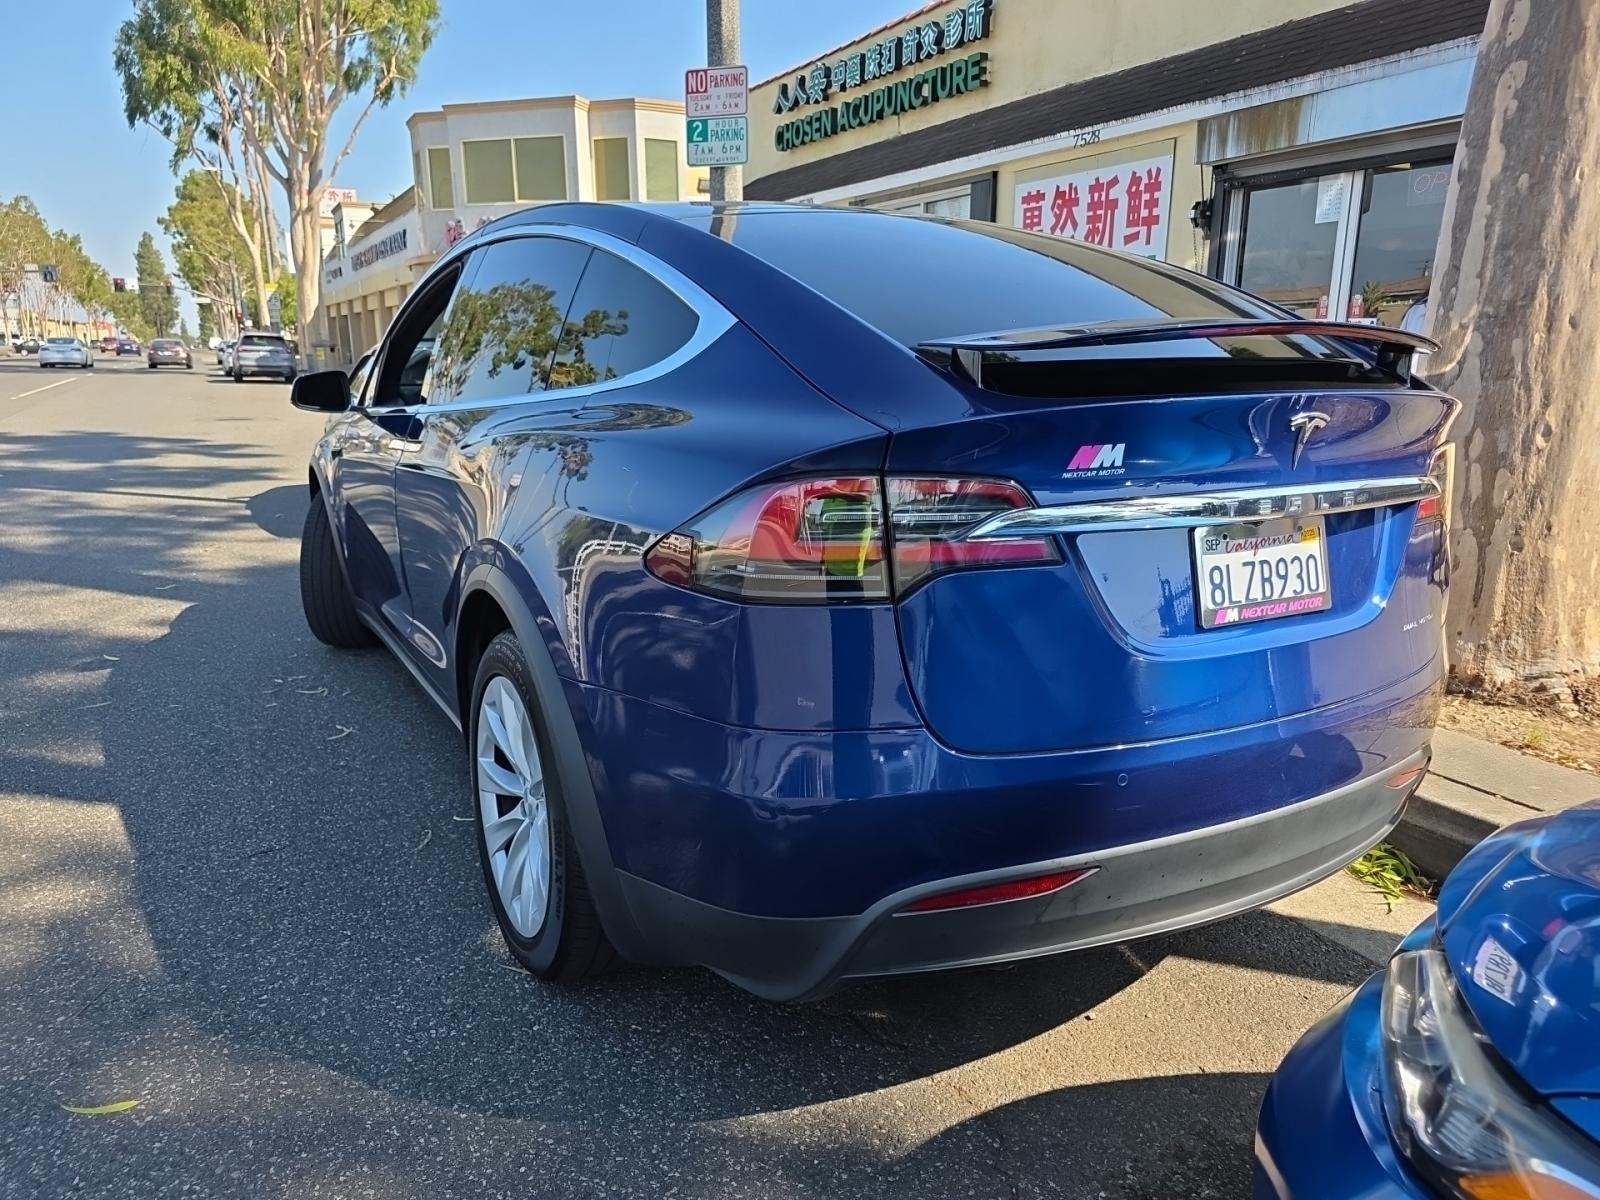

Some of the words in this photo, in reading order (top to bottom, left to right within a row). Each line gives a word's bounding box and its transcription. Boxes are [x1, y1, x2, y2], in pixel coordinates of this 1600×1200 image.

[687, 70, 706, 93] NO
[709, 73, 744, 88] PARKING
[775, 107, 833, 151] CHOSEN
[837, 53, 985, 132] ACUPUNCTURE
[692, 121, 703, 142] 2
[715, 120, 740, 128] HOUR
[710, 128, 744, 142] PARKING
[1073, 129, 1101, 149] 7528
[1061, 470, 1097, 479] NEXTCAR
[1097, 468, 1125, 477] MOTOR
[1205, 539, 1221, 552] SEP
[1225, 533, 1295, 557] California
[1208, 553, 1320, 608] 8LZB930
[1240, 604, 1287, 619] NEXTCAR
[1288, 597, 1323, 612] MOTOR
